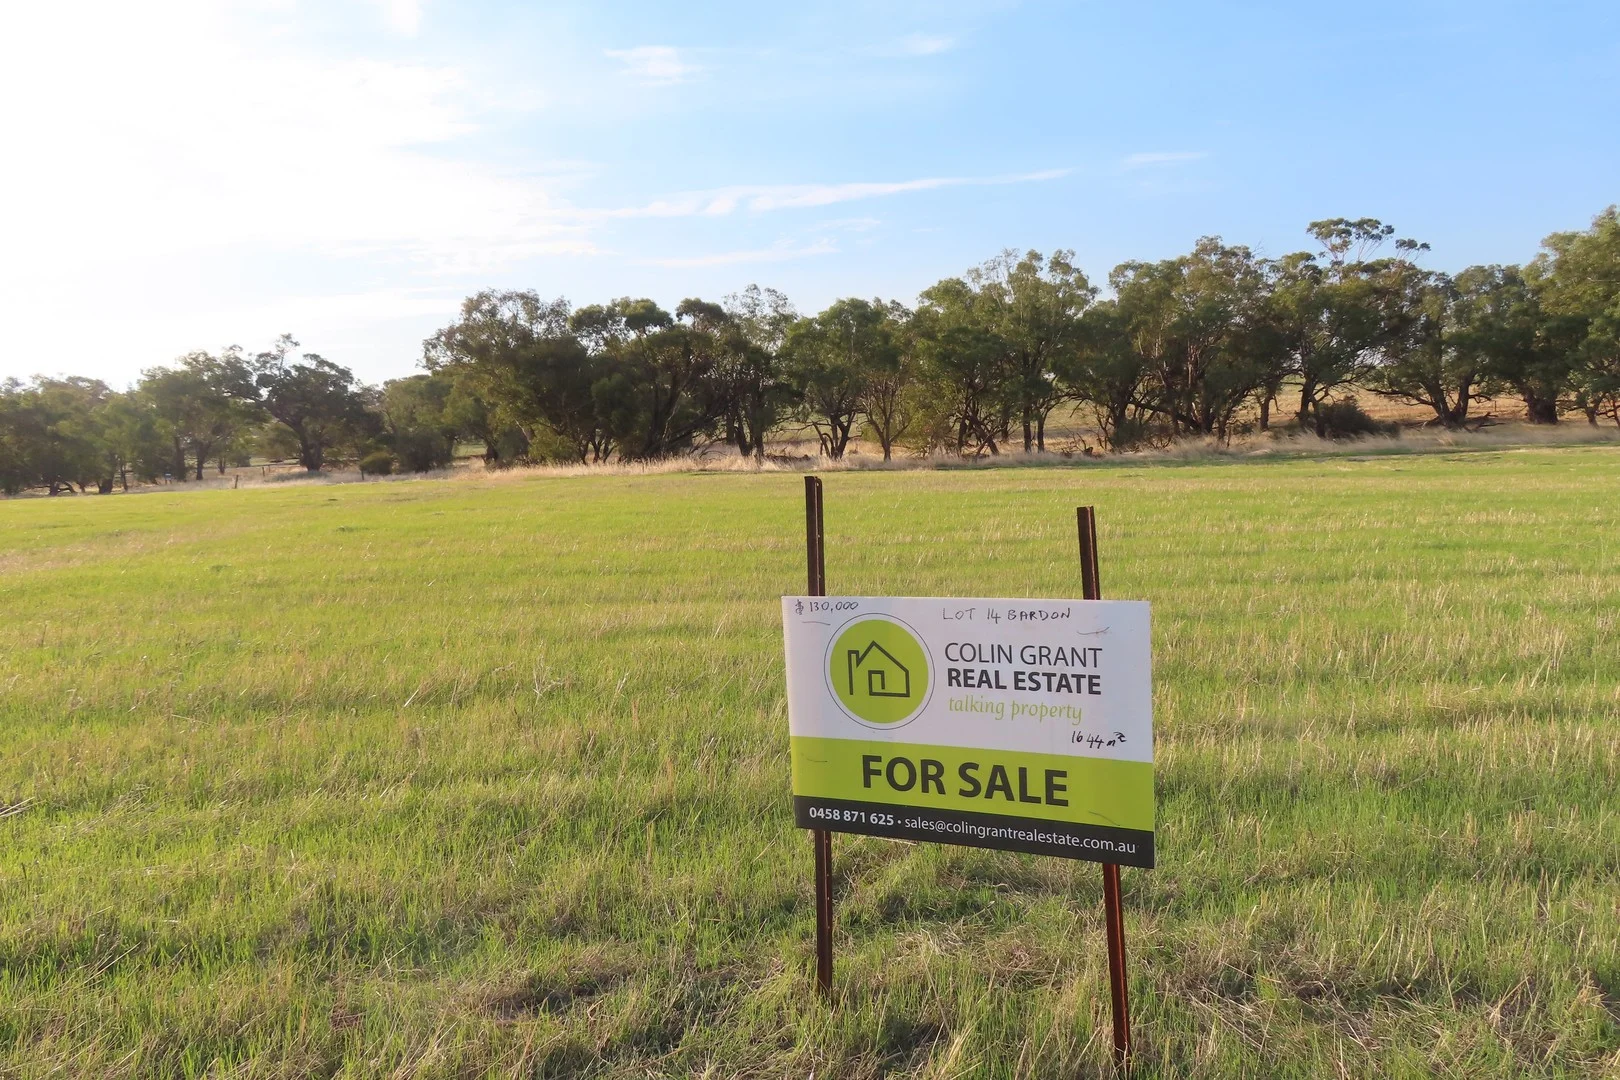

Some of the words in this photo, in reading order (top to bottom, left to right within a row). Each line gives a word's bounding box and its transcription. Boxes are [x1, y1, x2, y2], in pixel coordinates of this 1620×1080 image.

[943, 608, 976, 620] LOT
[987, 608, 1001, 624] 14
[1007, 607, 1071, 620] BARDON
[945, 642, 1013, 664] COLIN
[1020, 645, 1102, 668] GRANT
[947, 668, 1007, 690] REAL
[1014, 671, 1102, 695] ESTATE
[949, 695, 1004, 720] talking
[1011, 699, 1082, 725] property
[862, 755, 946, 795] FOR
[958, 762, 1069, 807] SALE
[809, 807, 841, 820] 0458
[843, 810, 866, 823] 871
[870, 813, 894, 826] 625
[905, 816, 1136, 853] sales@colingrantrealestate.com.au
